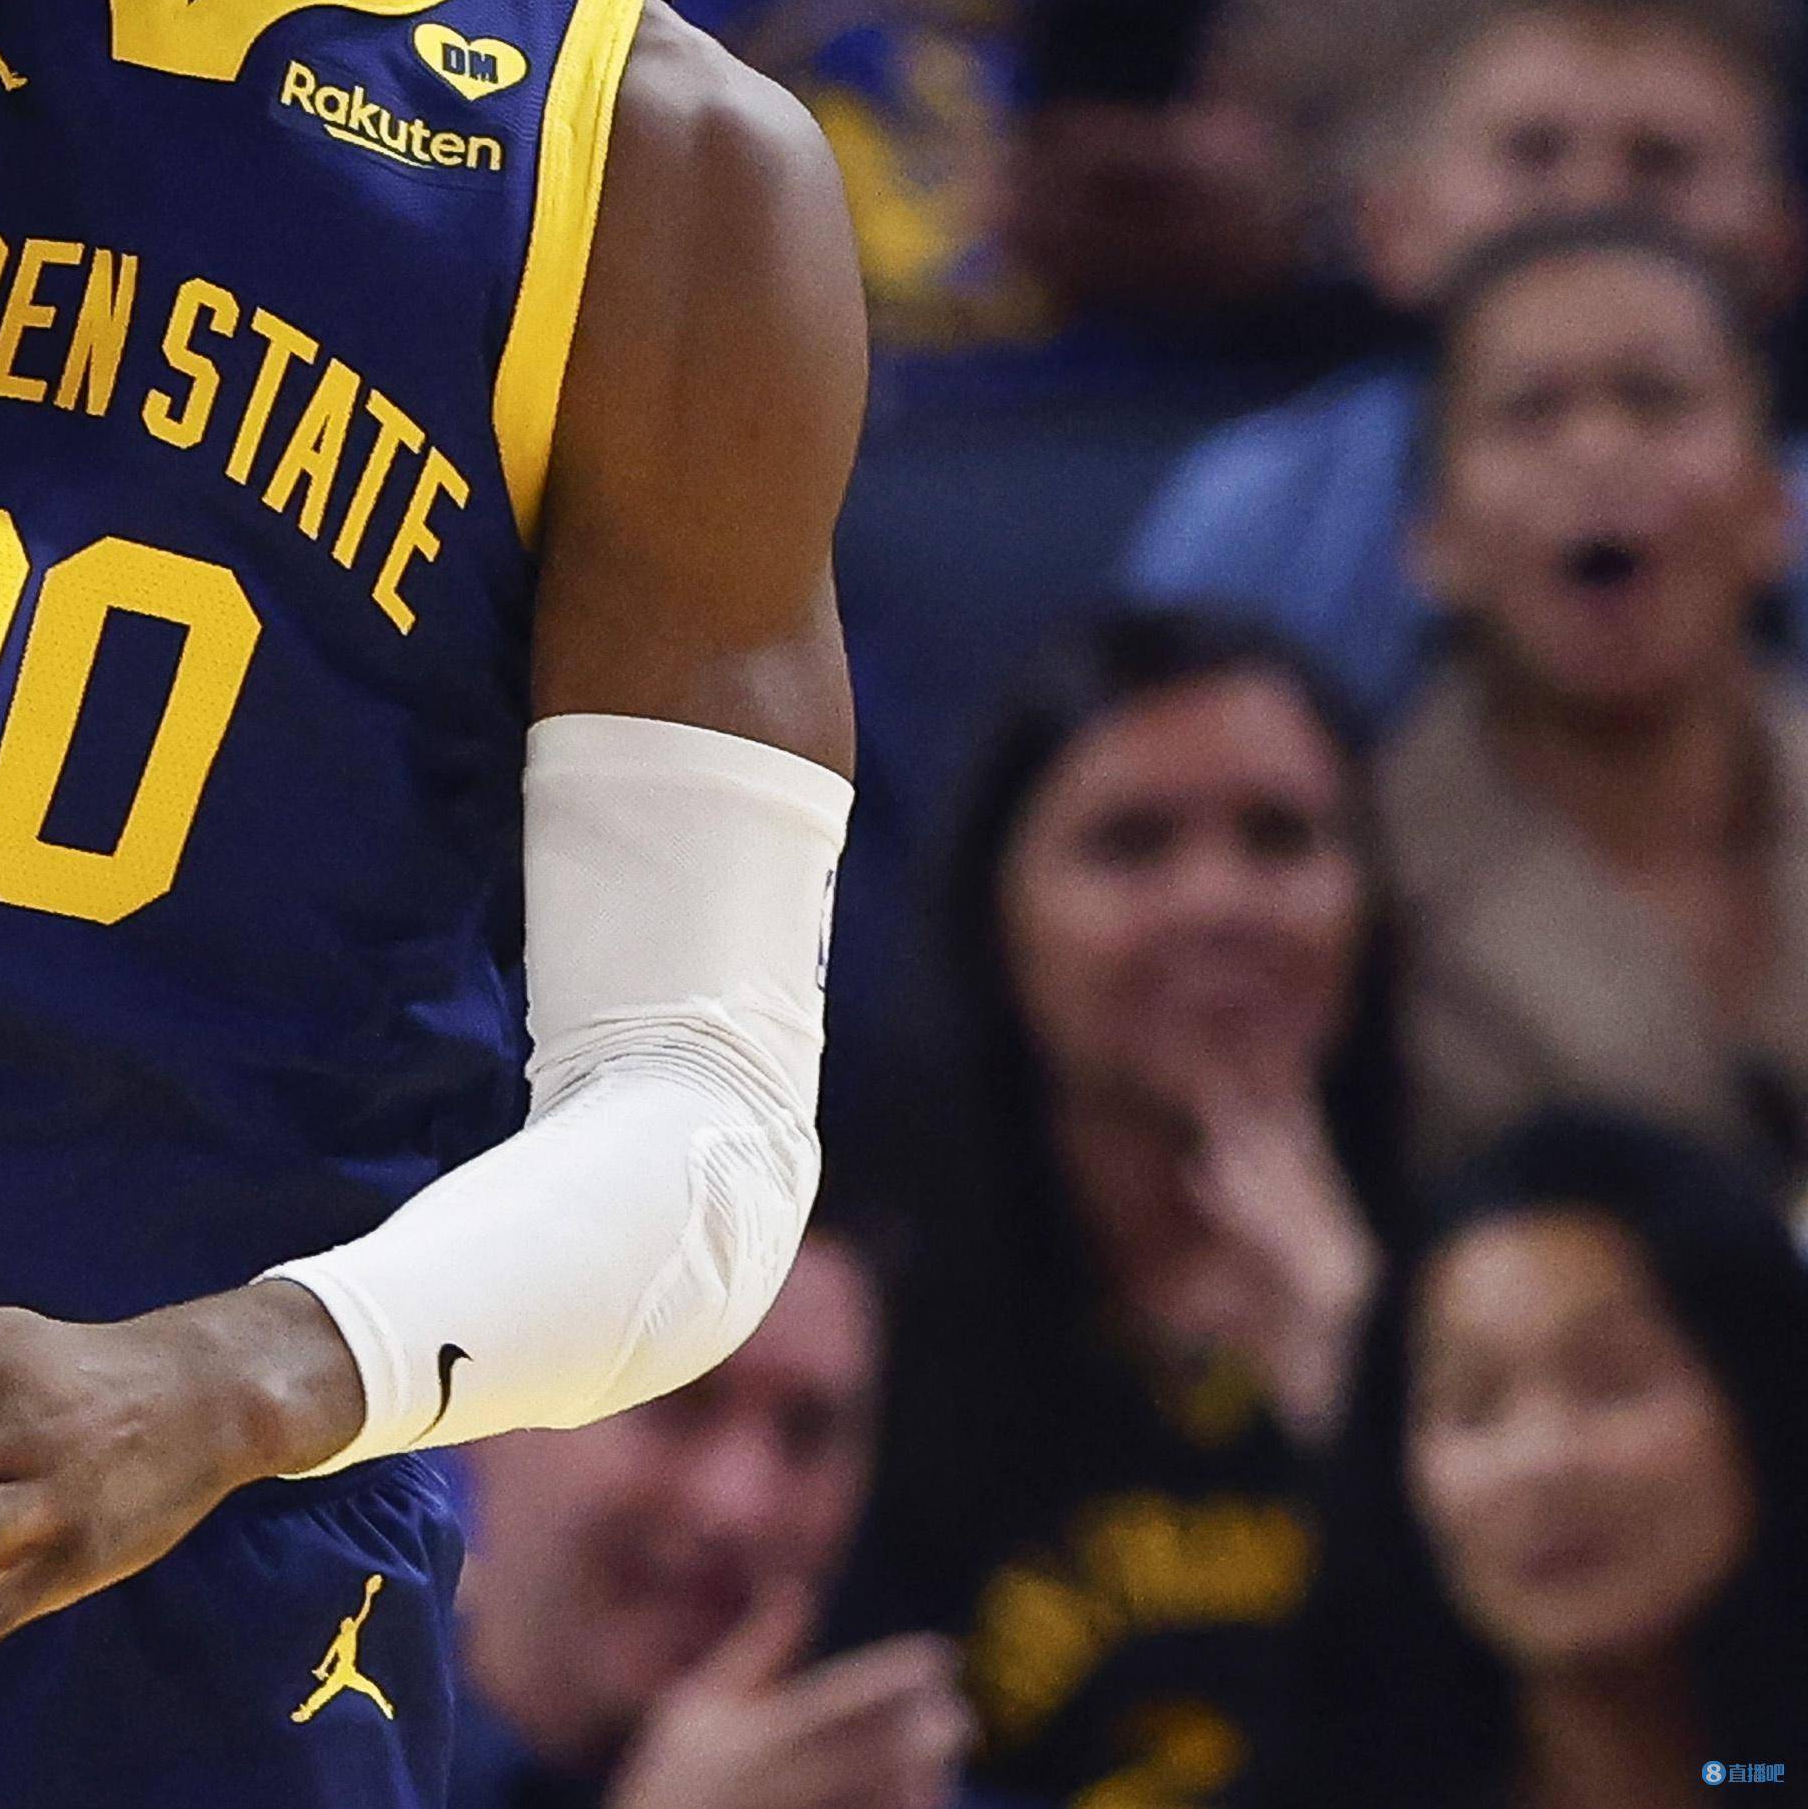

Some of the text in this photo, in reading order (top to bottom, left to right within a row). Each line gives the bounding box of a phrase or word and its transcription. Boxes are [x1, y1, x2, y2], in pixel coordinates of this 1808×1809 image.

[279, 60, 502, 172] Rakuten
[441, 42, 498, 84] DM
[142, 276, 471, 636] STATE
